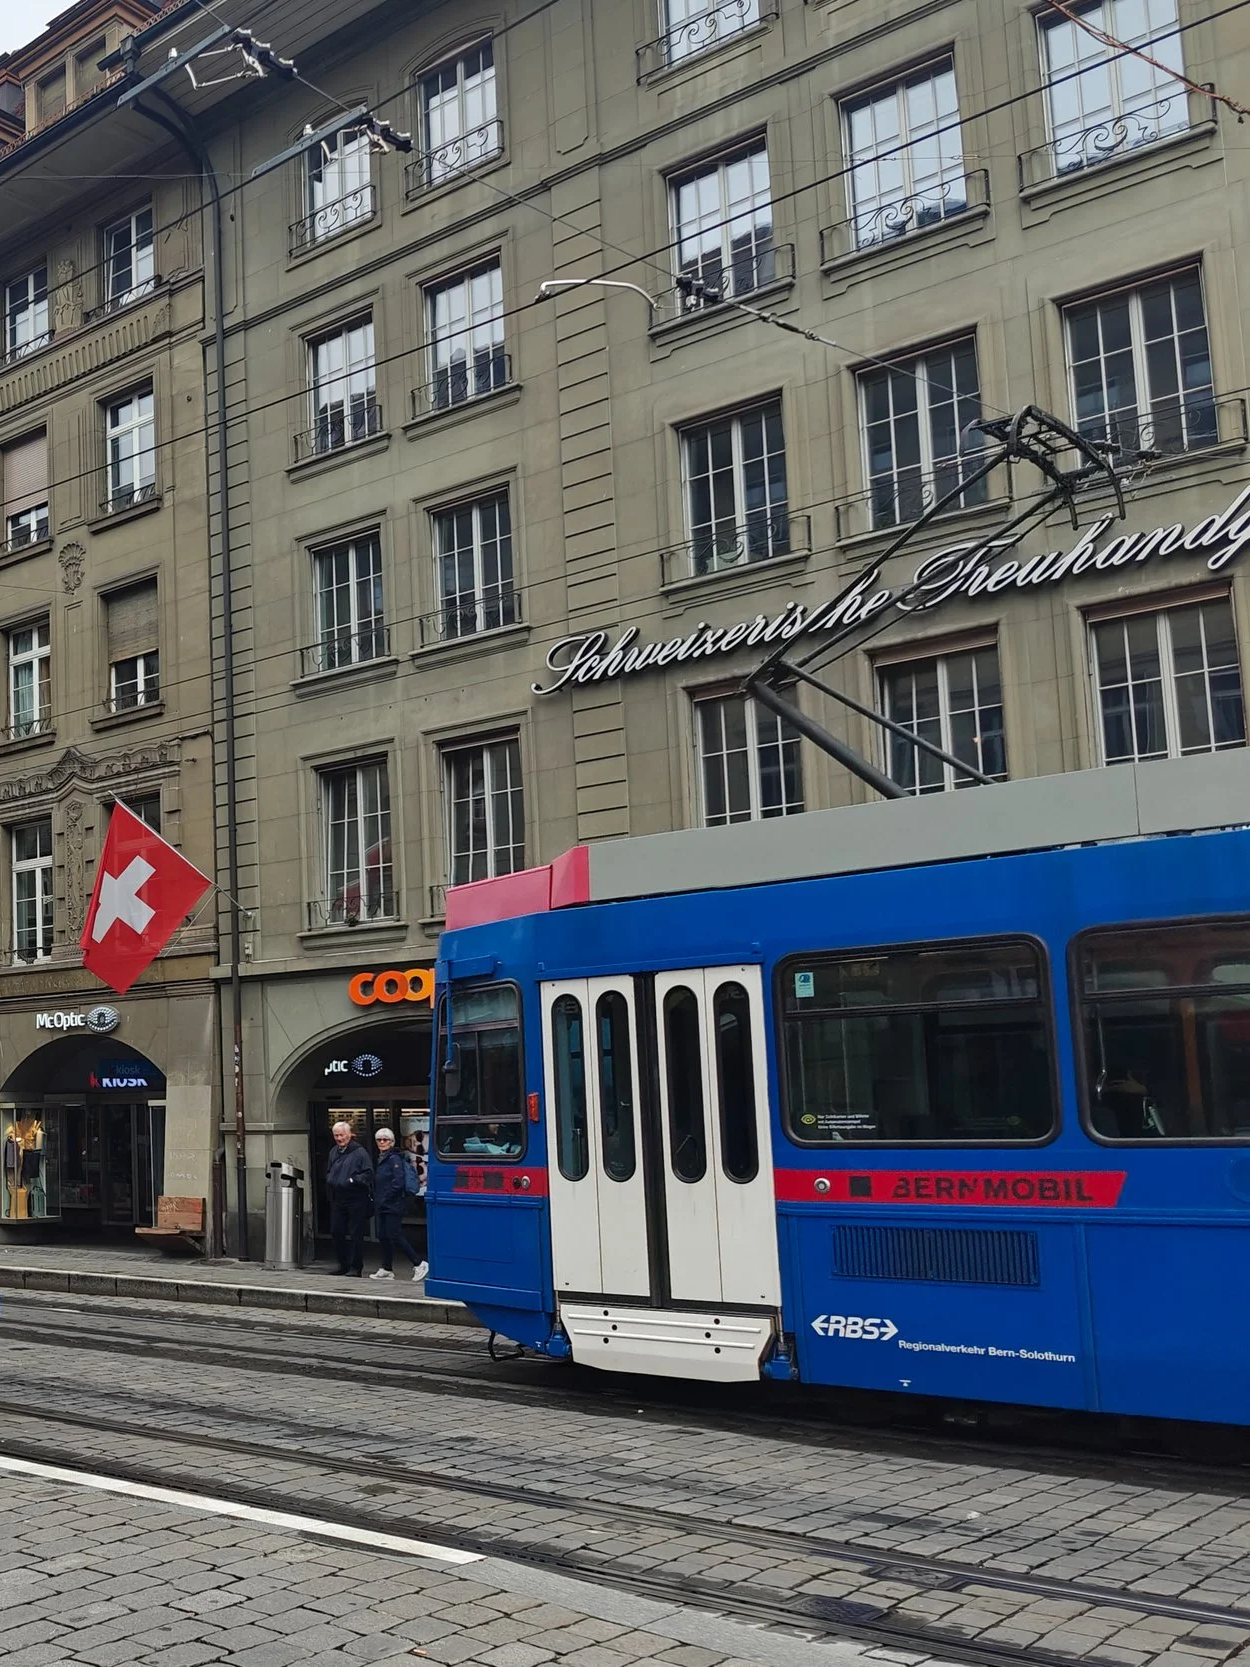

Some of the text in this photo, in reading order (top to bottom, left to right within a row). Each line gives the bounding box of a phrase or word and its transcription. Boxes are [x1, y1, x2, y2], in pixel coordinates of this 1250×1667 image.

[36, 1011, 86, 1031] McOptic
[828, 1315, 882, 1340] RBS
[898, 1340, 1076, 1363] Regionalverkehr Bern-Solothurn
